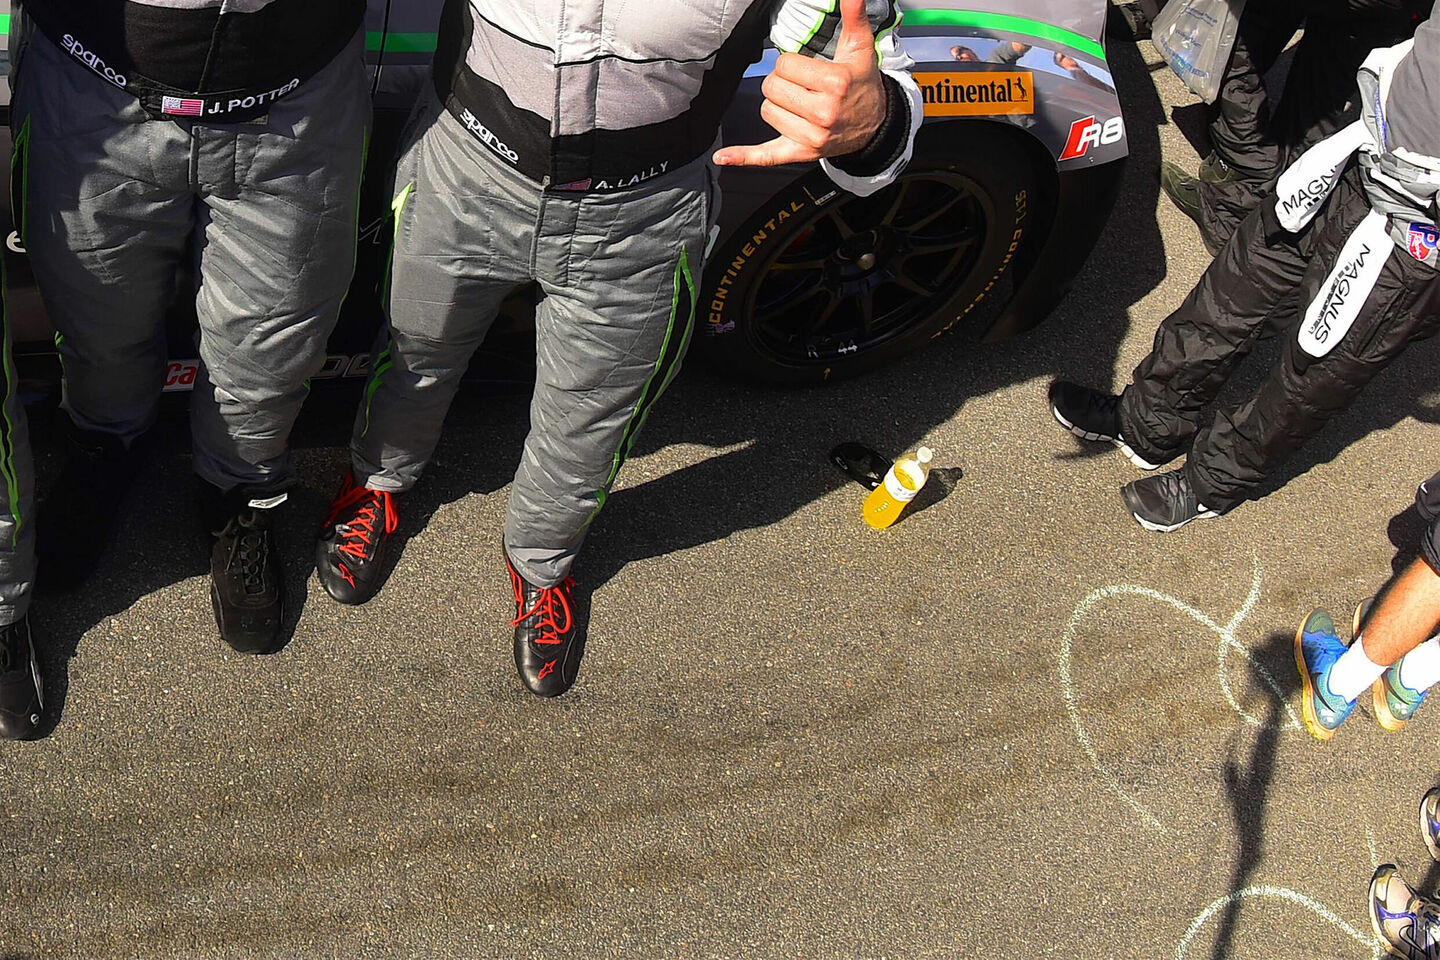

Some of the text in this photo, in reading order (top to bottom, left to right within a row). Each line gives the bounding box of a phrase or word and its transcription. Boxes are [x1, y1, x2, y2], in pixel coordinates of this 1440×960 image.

[60, 33, 127, 90] sparco
[208, 78, 300, 114] J. POTTER
[919, 78, 1013, 103] ntinental
[460, 108, 519, 165] sparco
[1076, 116, 1123, 153] R8
[595, 161, 669, 190] A. LALLY
[1282, 164, 1338, 215] MAGN
[709, 200, 805, 324] CONTINENTAL
[1315, 243, 1371, 344] MAGNUS
